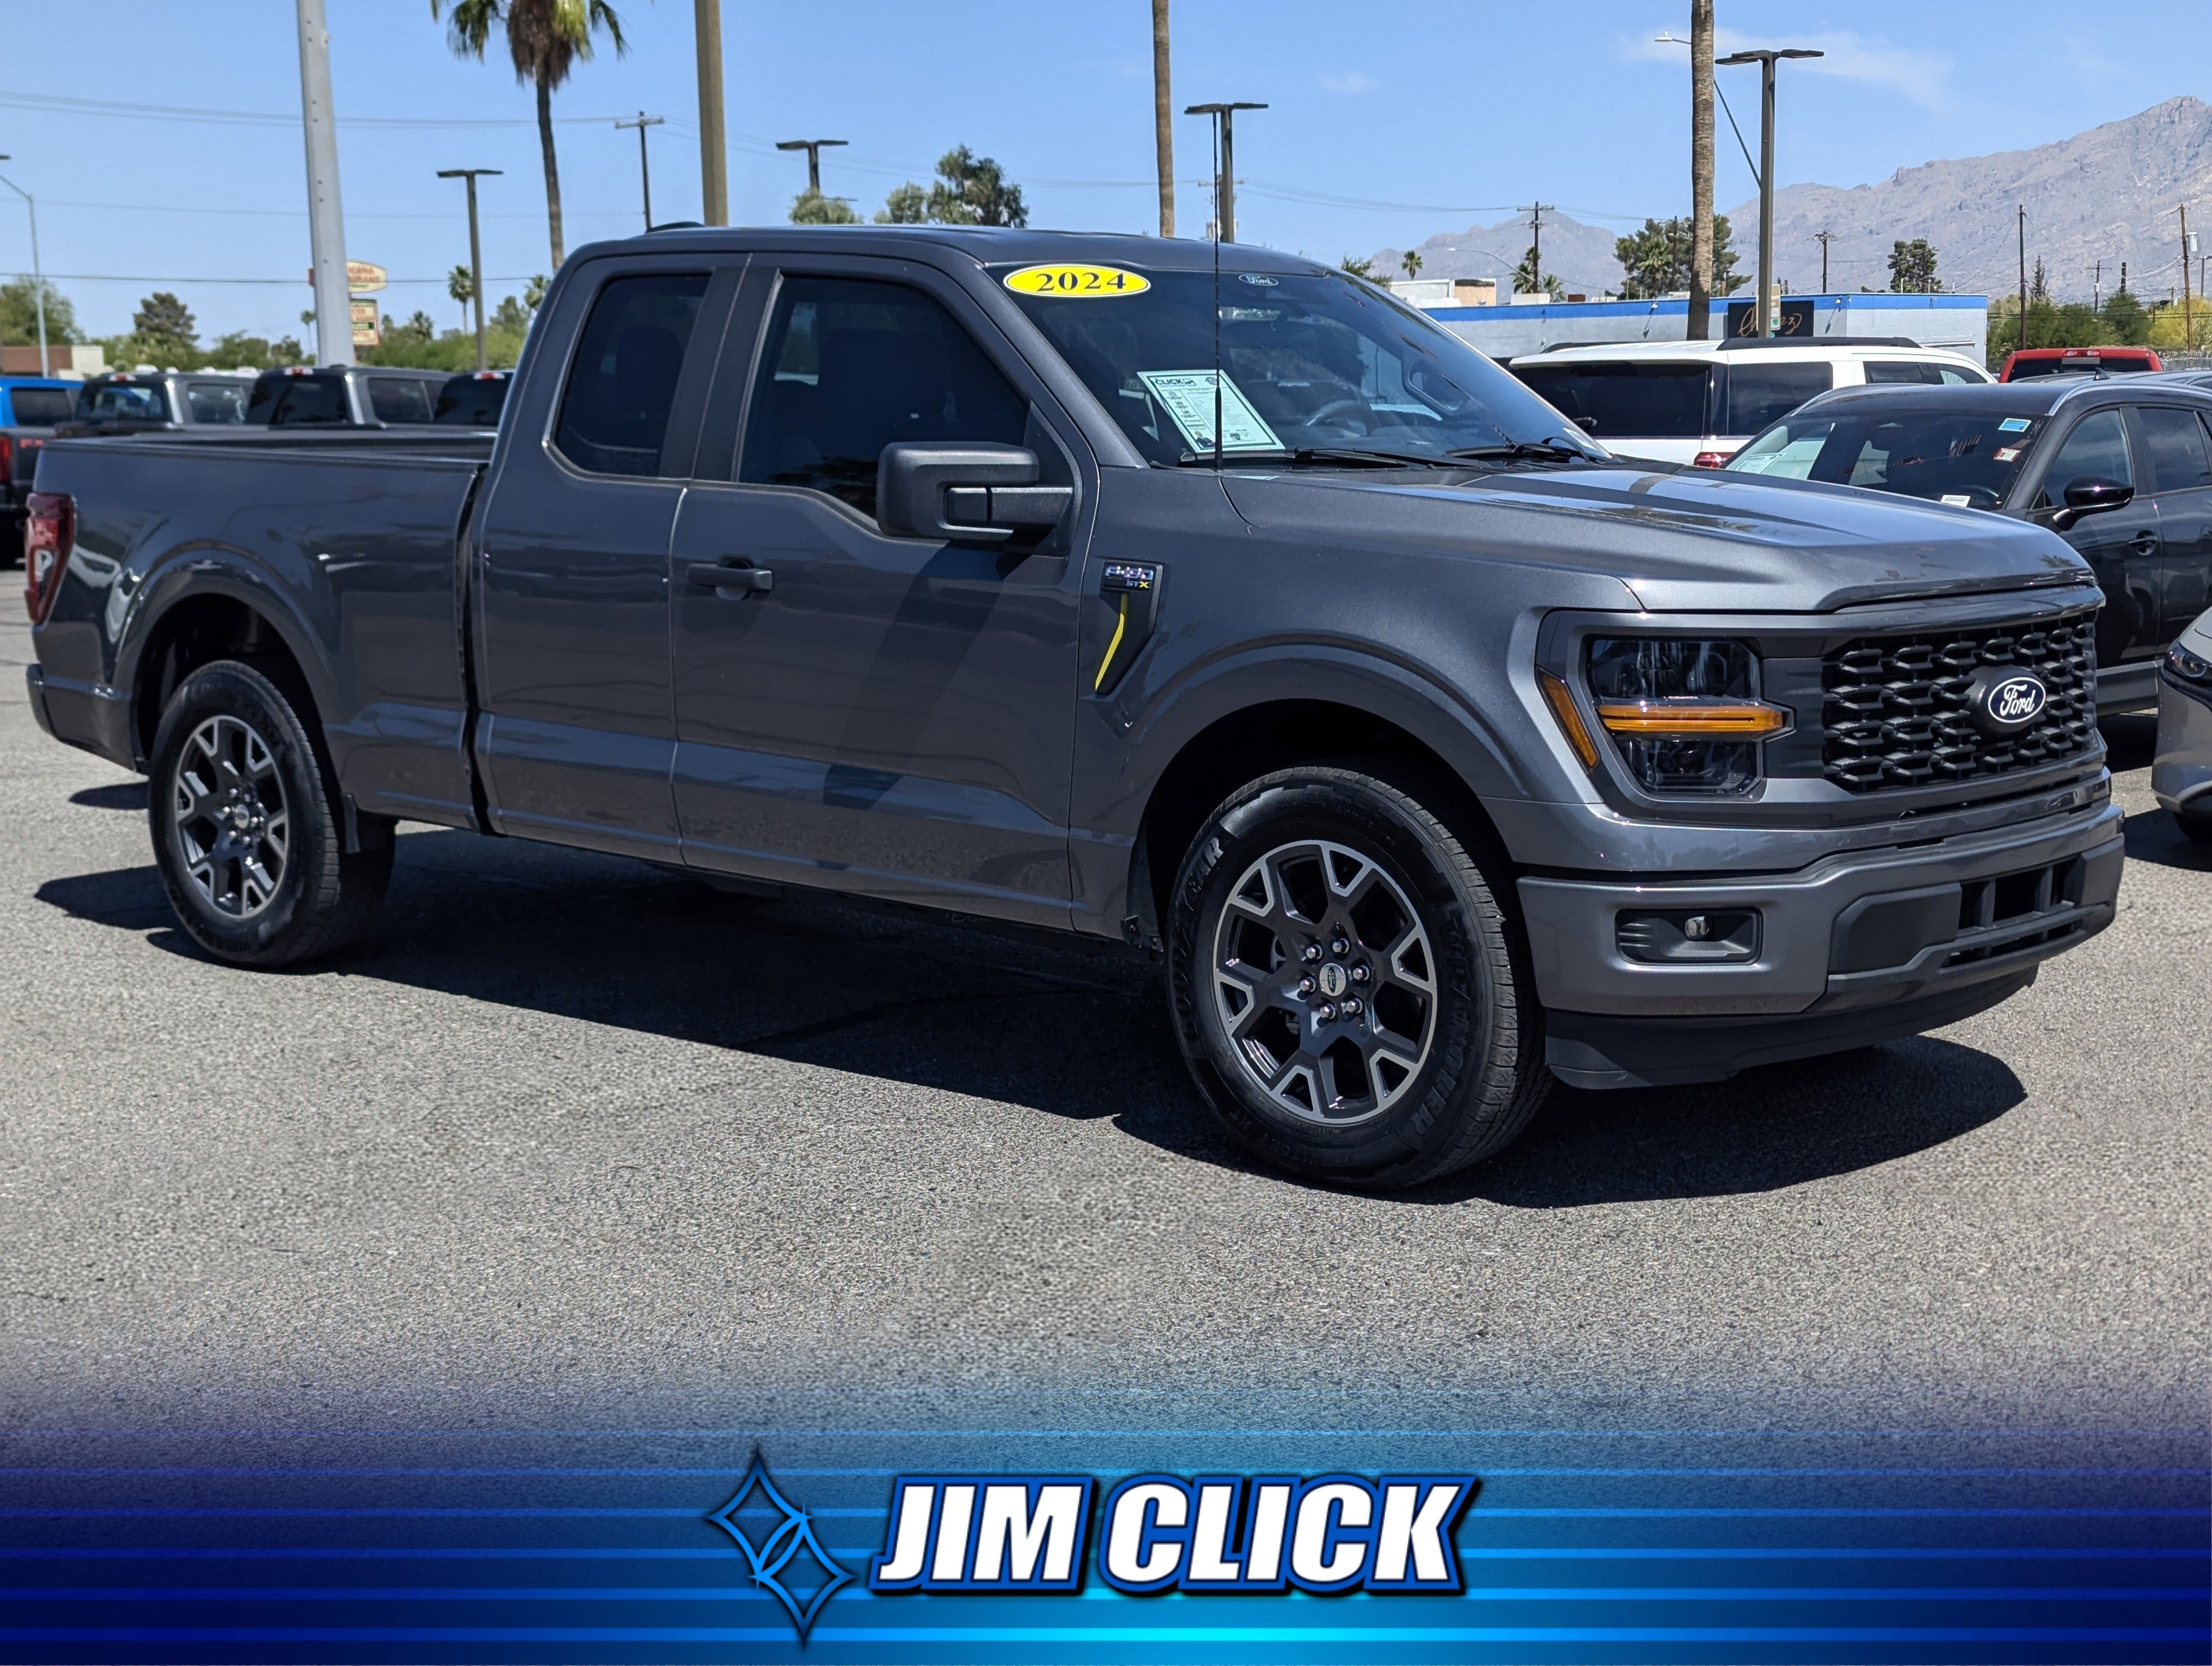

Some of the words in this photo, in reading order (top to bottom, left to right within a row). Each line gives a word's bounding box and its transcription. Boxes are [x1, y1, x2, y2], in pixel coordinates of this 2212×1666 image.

[1035, 271, 1126, 292] 2024
[1126, 580, 1149, 588] STX
[1999, 684, 2036, 716] Ford
